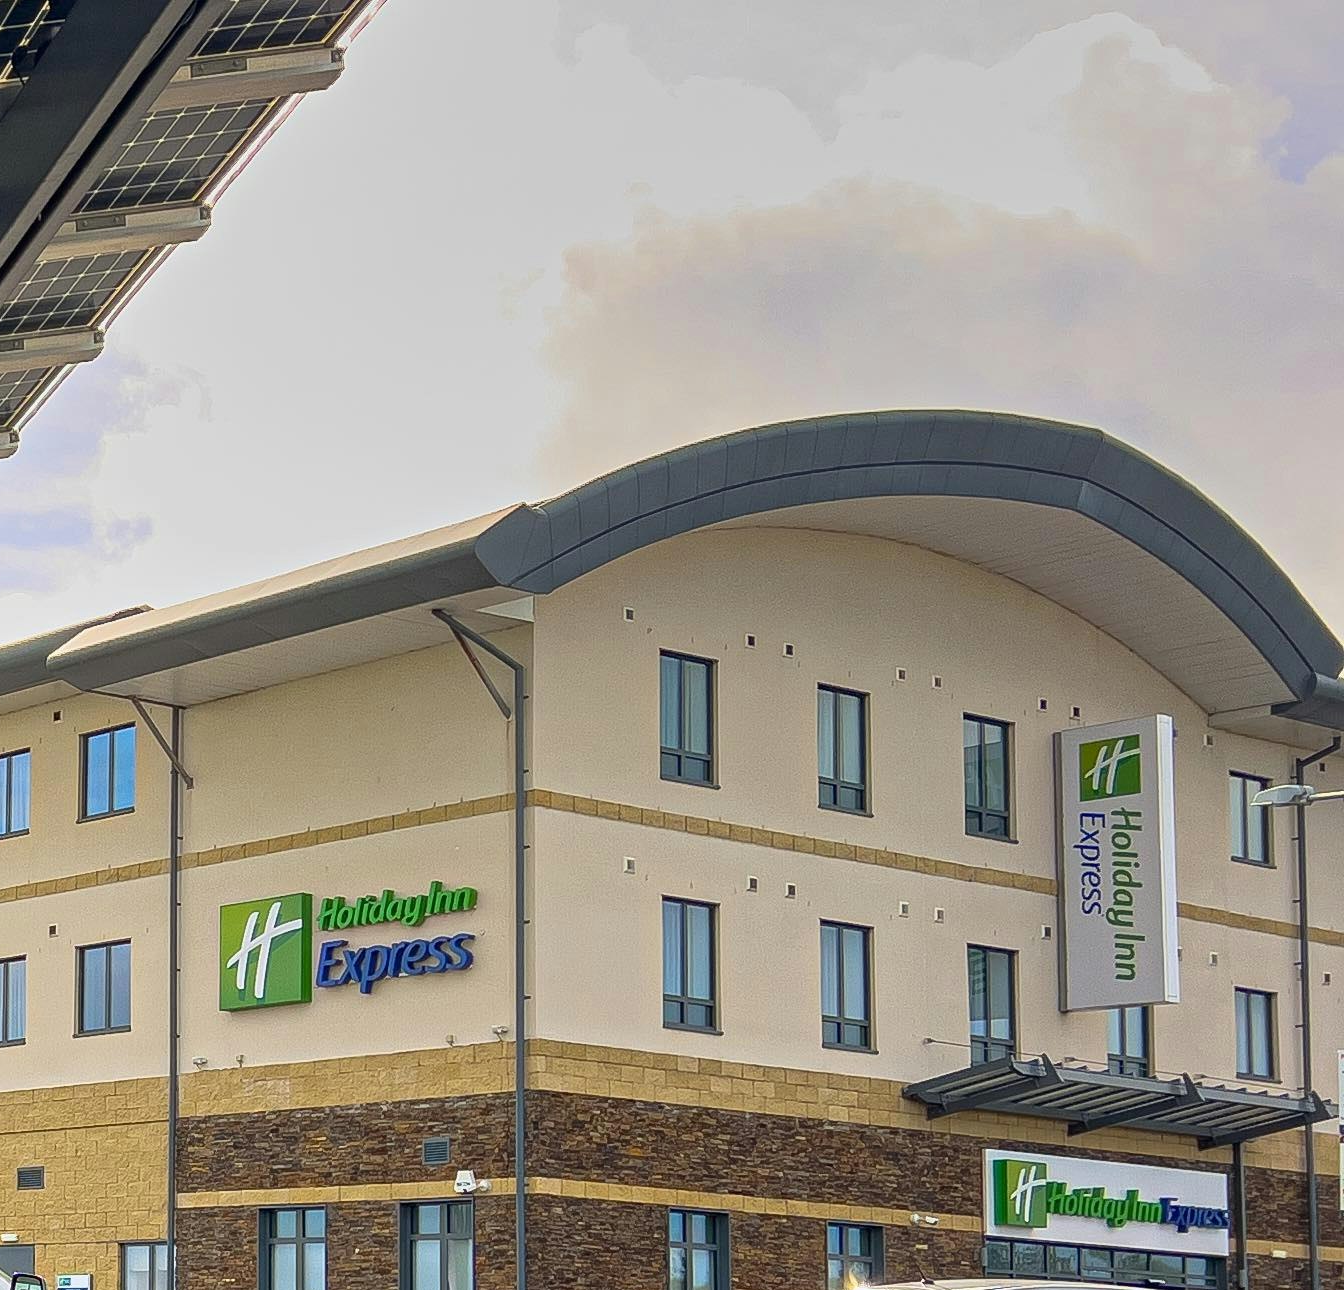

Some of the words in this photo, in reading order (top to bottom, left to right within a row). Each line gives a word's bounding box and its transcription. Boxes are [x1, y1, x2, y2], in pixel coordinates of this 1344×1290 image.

[1073, 811, 1105, 915] Express
[1105, 807, 1143, 927] Holiday
[316, 889, 428, 931] Holiday
[424, 880, 478, 917] Inn
[315, 932, 476, 995] Express
[1114, 932, 1146, 981] Inn
[1047, 1181, 1130, 1229] Holiday
[1126, 1189, 1162, 1224] Inn
[1160, 1197, 1232, 1233] Express
